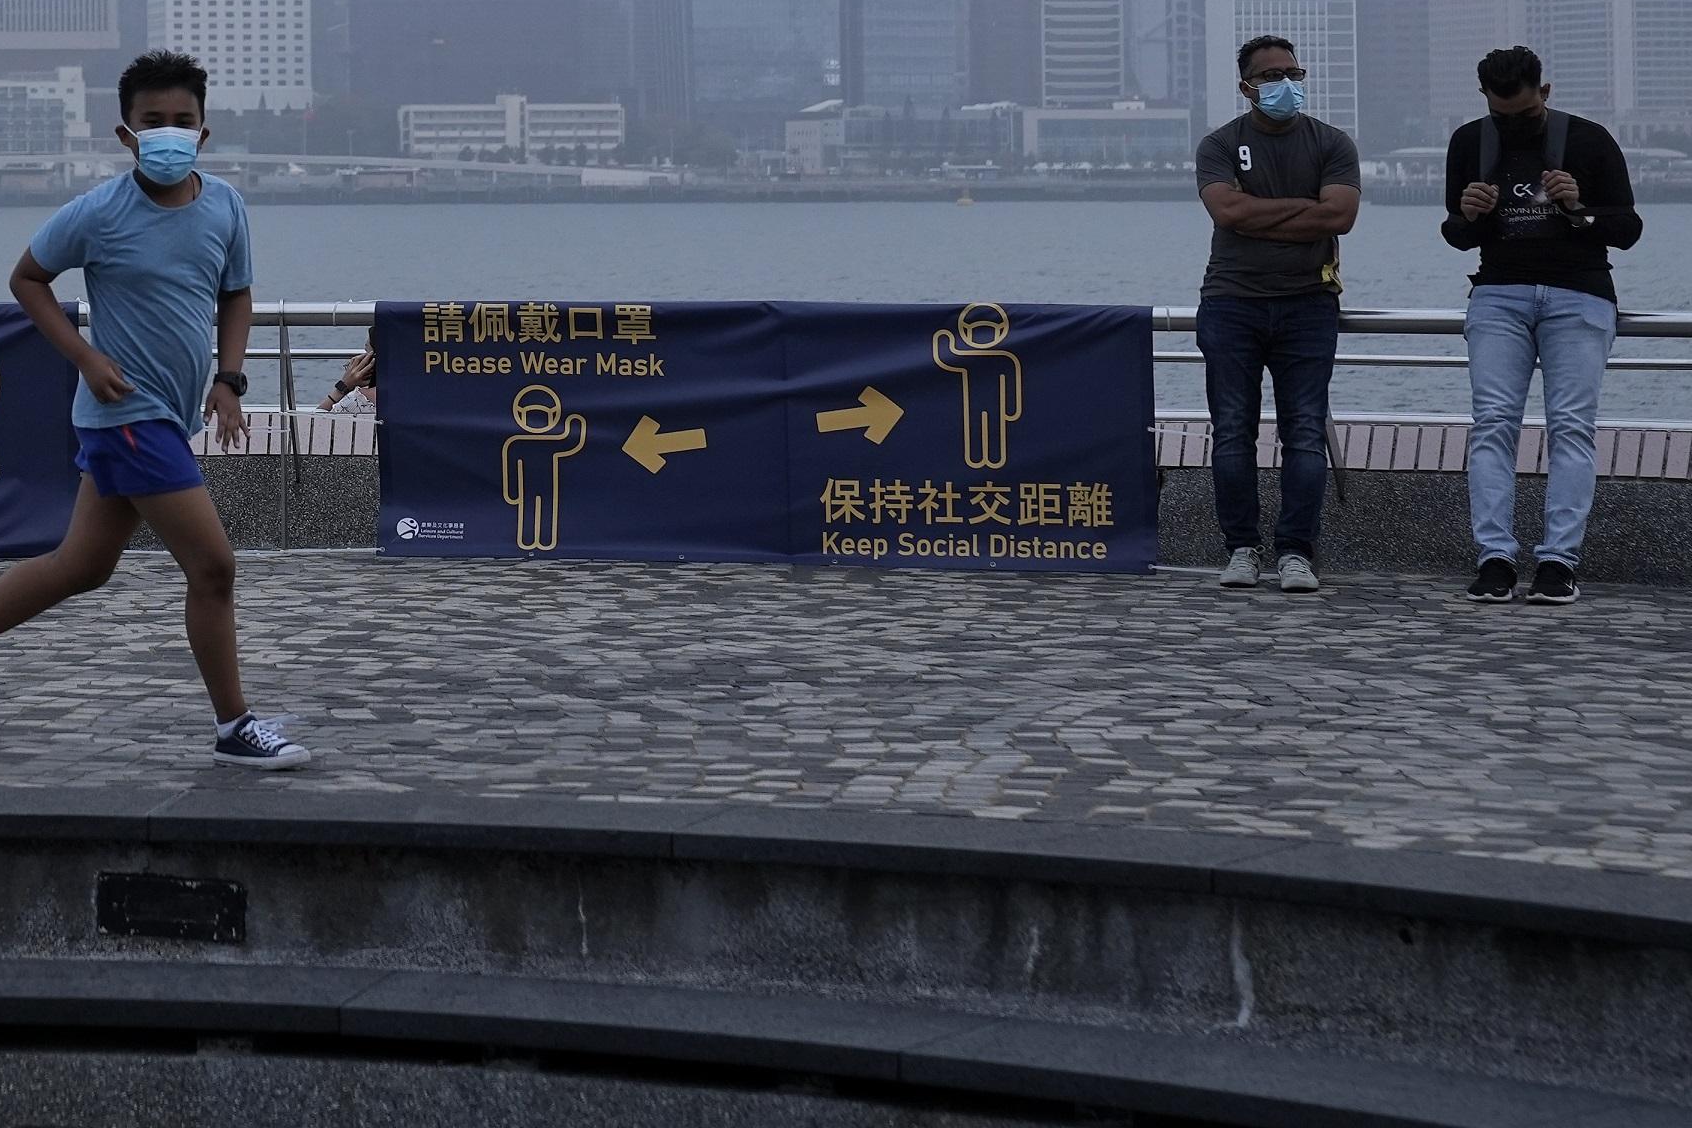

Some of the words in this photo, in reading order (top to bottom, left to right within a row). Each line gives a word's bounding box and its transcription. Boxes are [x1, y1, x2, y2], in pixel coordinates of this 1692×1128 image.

[1238, 145, 1252, 171] 9
[422, 302, 657, 345] 請佩戴口罩
[425, 351, 512, 374] Please
[519, 351, 588, 375] Wear
[595, 352, 665, 377] Mask
[819, 477, 1114, 527] 保持社交距離
[821, 531, 888, 560] Keep
[898, 532, 980, 557] Social
[989, 534, 1108, 560] Distance
